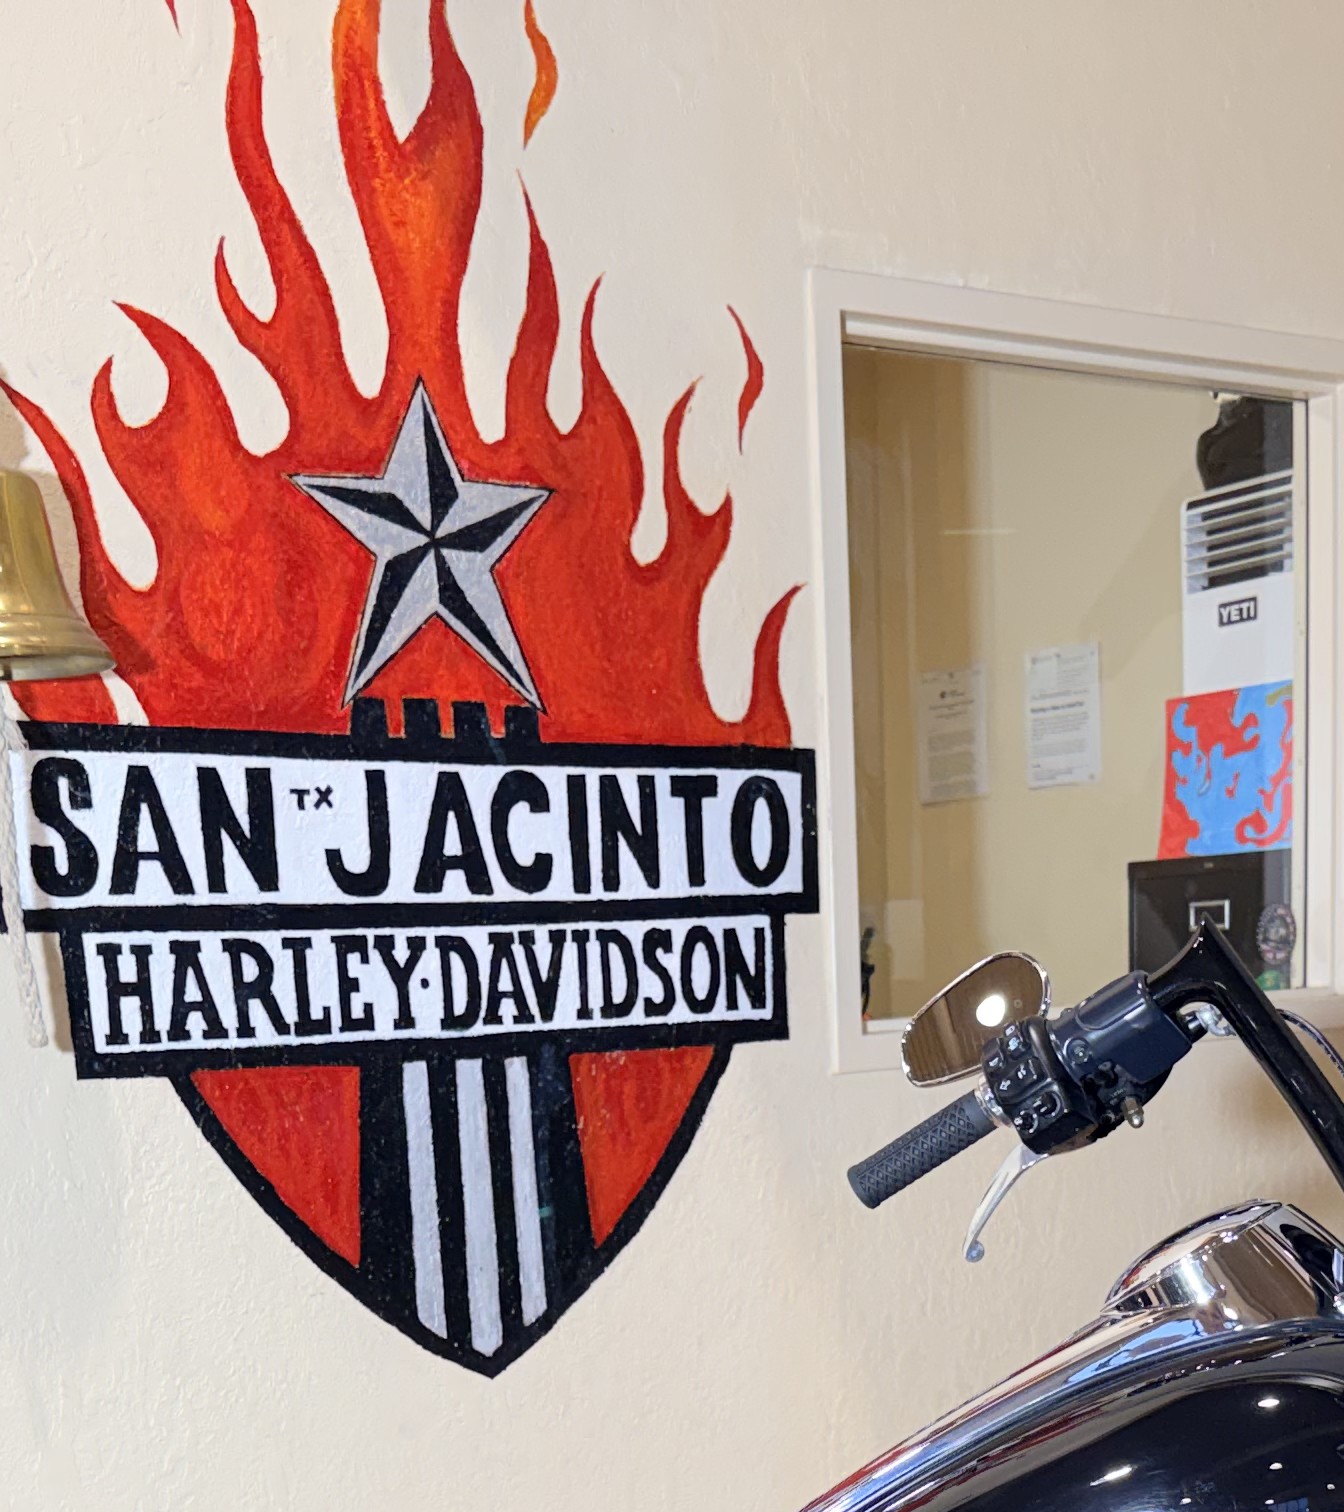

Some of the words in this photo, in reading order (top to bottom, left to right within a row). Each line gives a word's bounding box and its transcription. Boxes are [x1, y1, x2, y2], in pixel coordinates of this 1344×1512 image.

[1219, 601, 1255, 623] YETI
[30, 757, 280, 897] SAN
[289, 785, 334, 811] TX
[325, 770, 790, 897] JACINTO
